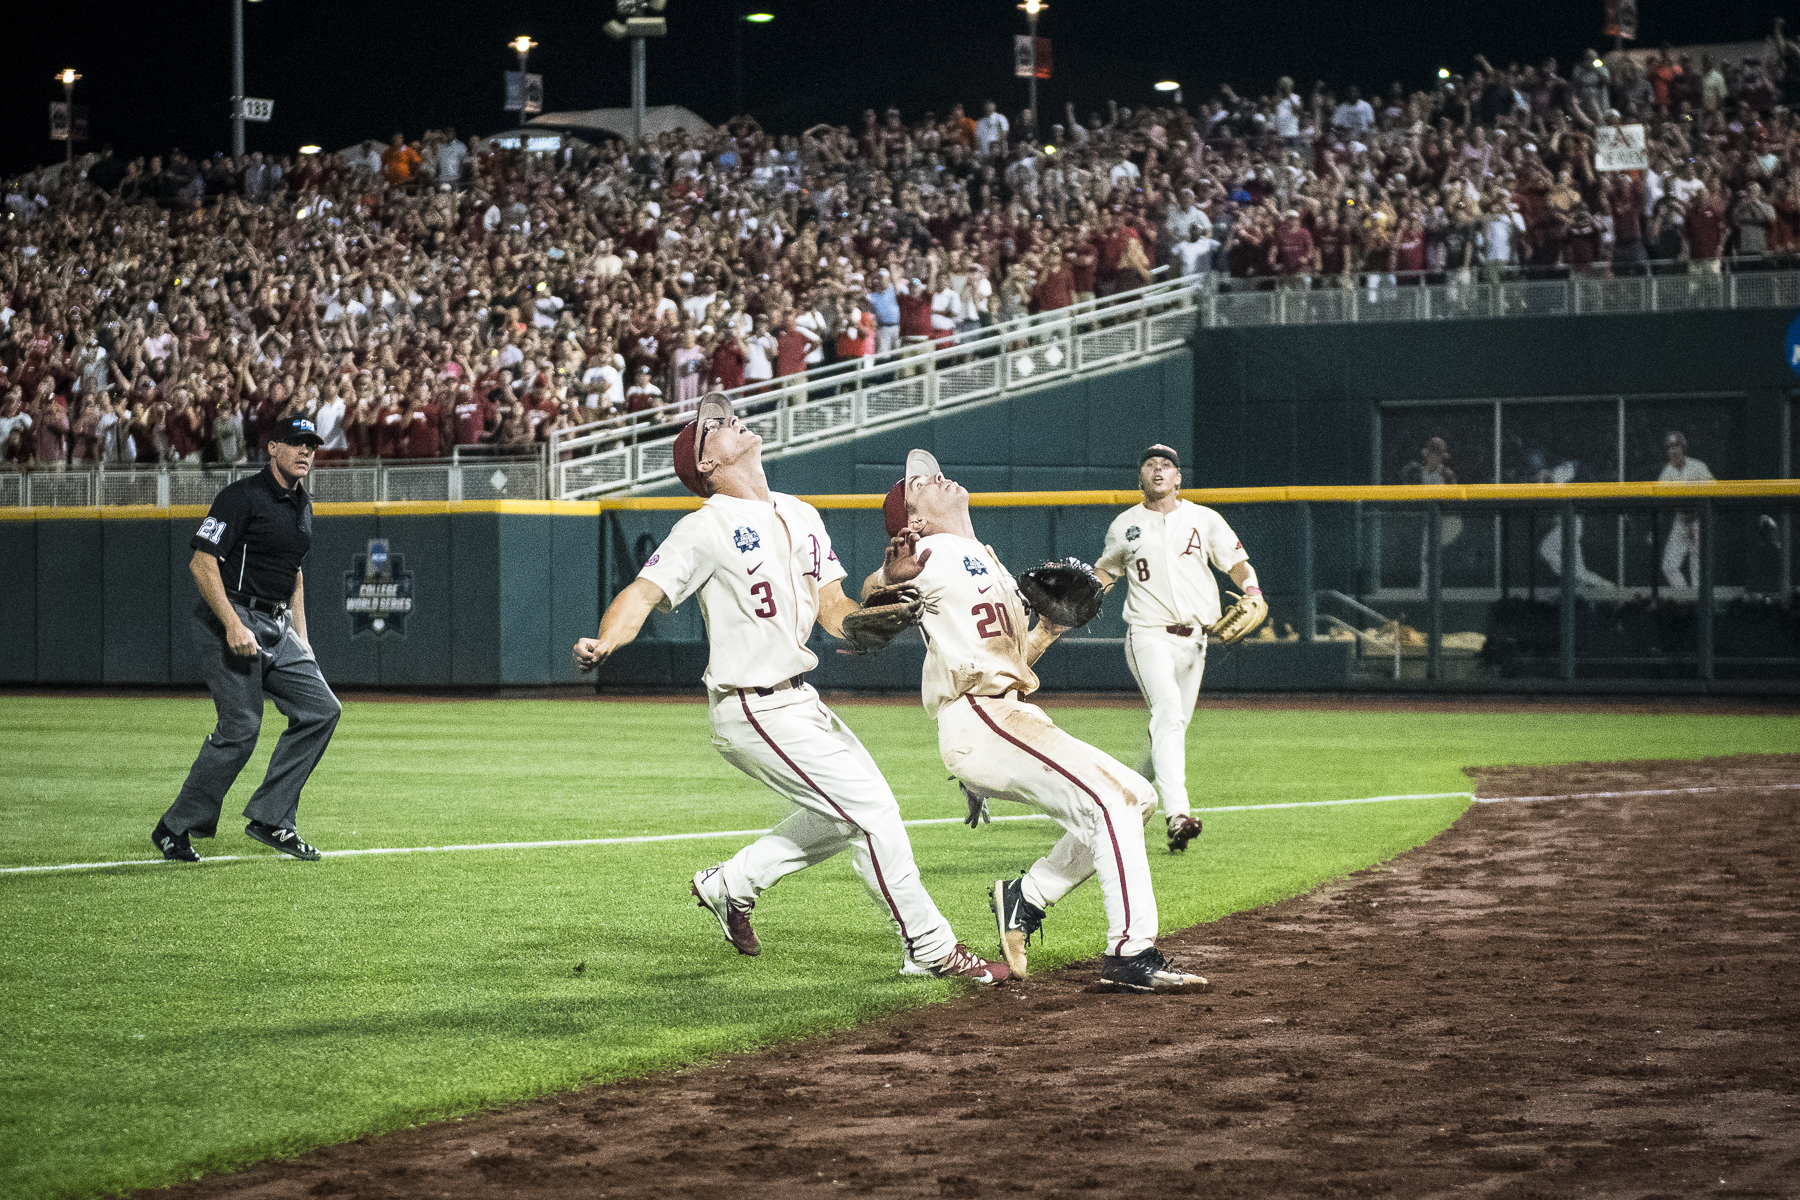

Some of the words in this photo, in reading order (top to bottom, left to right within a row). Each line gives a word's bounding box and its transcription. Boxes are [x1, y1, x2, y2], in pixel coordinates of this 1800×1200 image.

[195, 516, 227, 544] 21
[1178, 527, 1204, 559] A
[1135, 557, 1151, 582] 8
[345, 597, 379, 611] WORLD
[379, 597, 412, 611] SERIES
[359, 583, 398, 597] COLLEGE
[750, 581, 778, 619] 3
[971, 602, 1014, 639] 20
